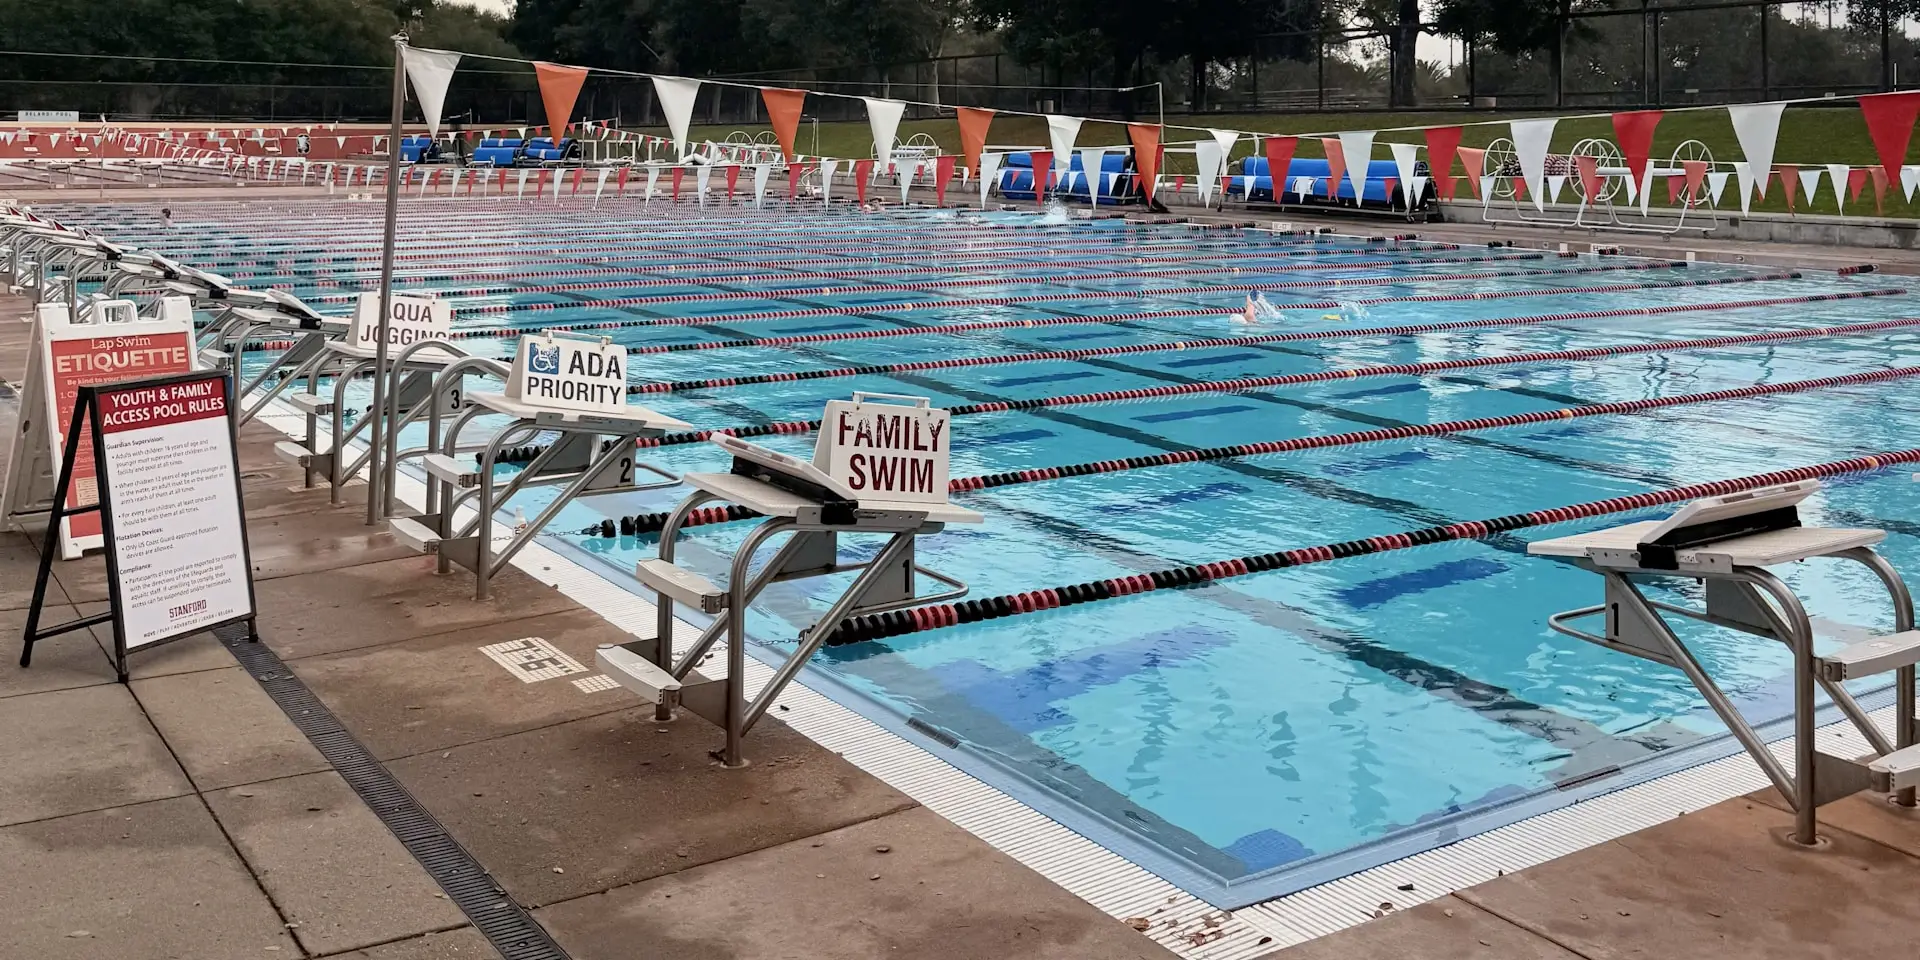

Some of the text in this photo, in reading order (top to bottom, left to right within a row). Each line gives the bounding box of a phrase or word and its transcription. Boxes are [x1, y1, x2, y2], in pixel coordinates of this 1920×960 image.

[389, 302, 432, 322] QUA
[92, 337, 151, 350] Lap Swim
[56, 347, 186, 372] ETIQUETTE
[568, 350, 622, 380] ADA
[103, 376, 119, 384] your
[527, 376, 621, 405] PRIORITY
[111, 382, 213, 408] YOUTH & FAMILY
[451, 389, 460, 410] 3
[103, 407, 150, 427] ACCESS
[153, 403, 186, 419] POOL
[189, 397, 224, 414] RULES
[838, 410, 944, 452] FAMILY
[107, 437, 164, 449] Guardian Supervision:
[171, 444, 183, 452] years
[116, 459, 137, 468] younger
[620, 457, 631, 483] 2
[848, 453, 934, 493] SWIM
[135, 479, 154, 487] children
[142, 528, 163, 536] Devices:
[120, 564, 152, 574] Compliance:
[902, 559, 910, 594] 1
[169, 599, 207, 618] STANFORD
[1611, 602, 1619, 636] 1
